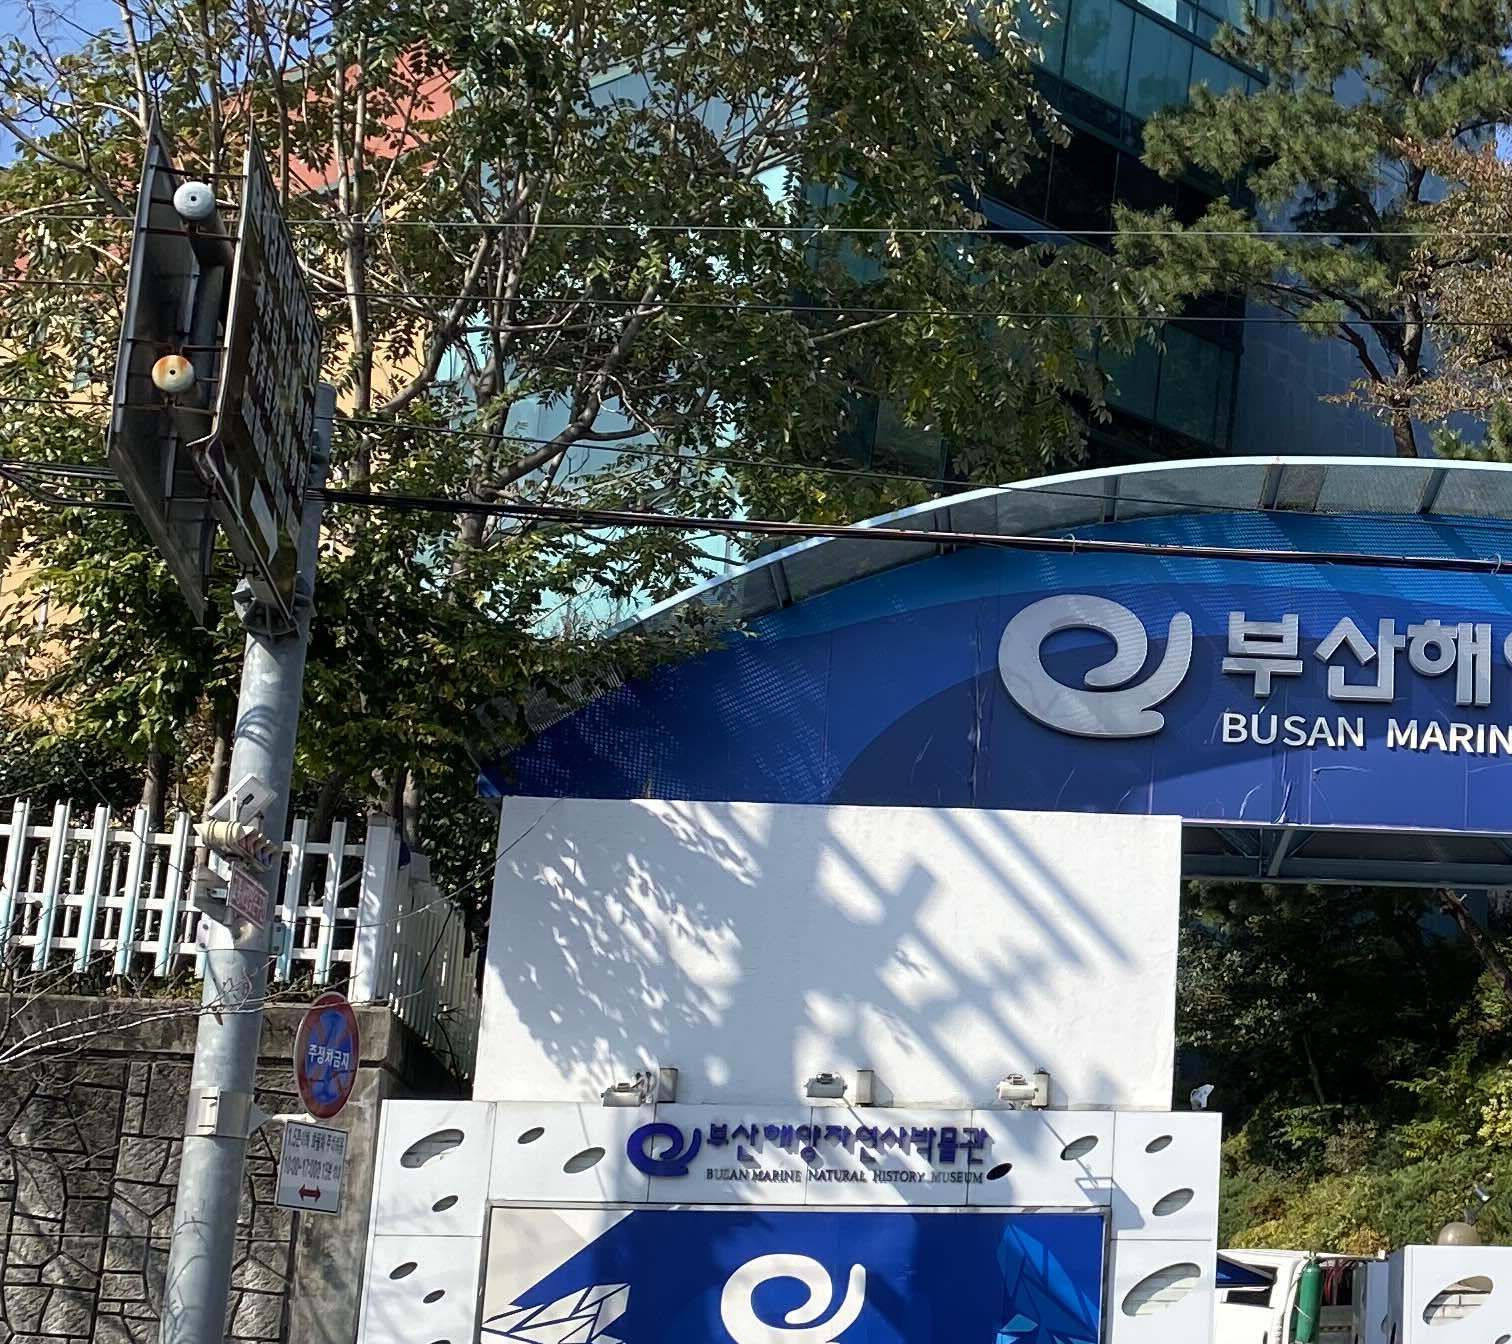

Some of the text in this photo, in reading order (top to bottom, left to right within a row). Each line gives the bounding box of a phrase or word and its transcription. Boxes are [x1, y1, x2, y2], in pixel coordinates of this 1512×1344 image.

[1222, 712, 1364, 748] BUSAN
[308, 1044, 350, 1070] 주정차금지
[707, 1123, 987, 1164] 부산해양자연사박물관
[752, 1168, 802, 1183] MARINE
[807, 1168, 867, 1183] NATURAL
[873, 1169, 926, 1183] HISTORY
[931, 1170, 984, 1184] MUSEUM
